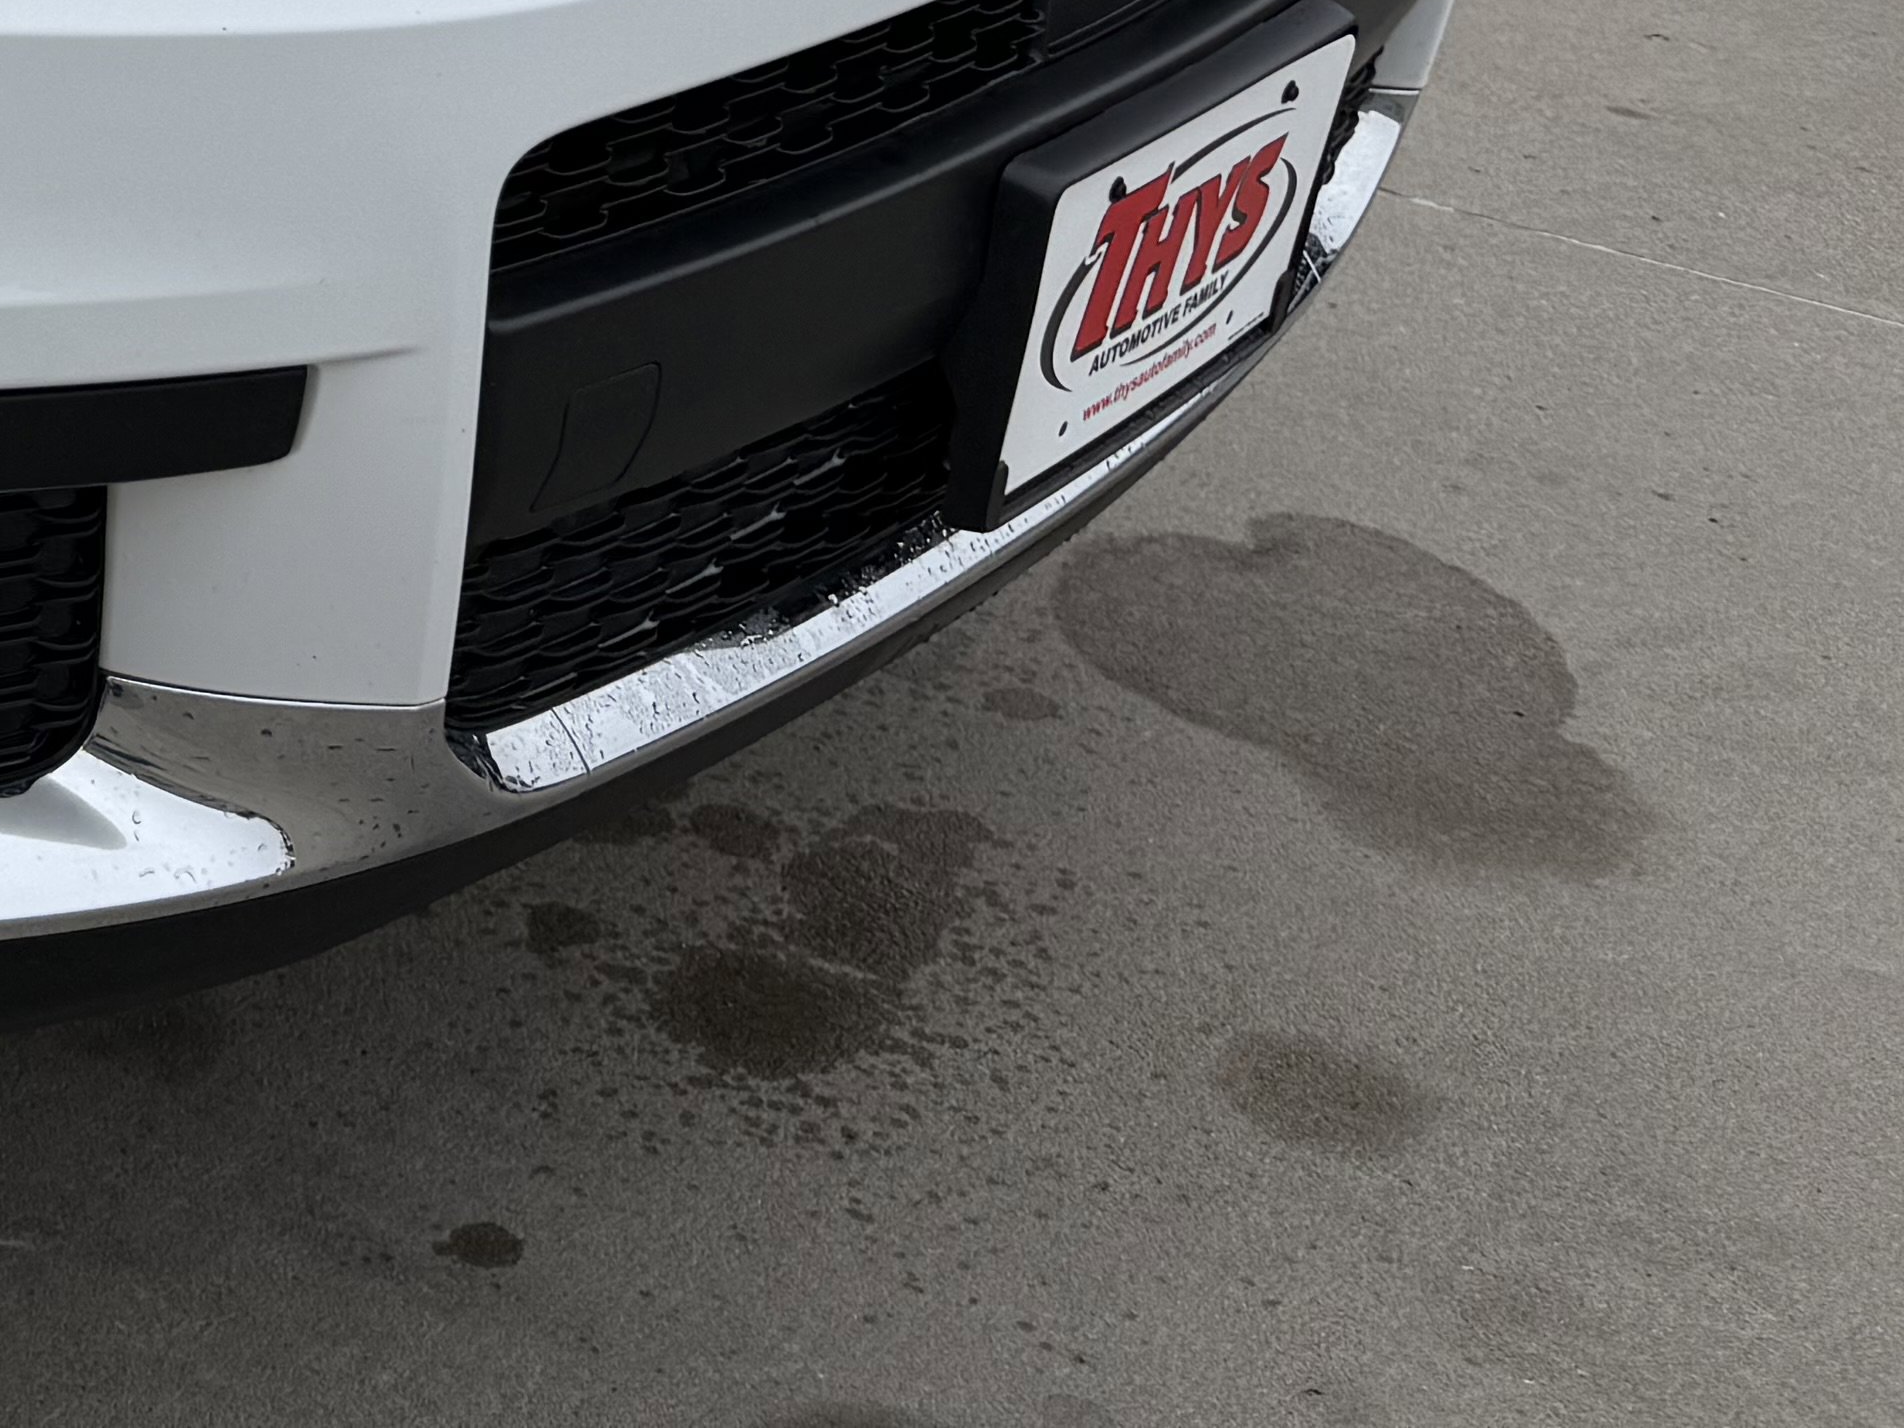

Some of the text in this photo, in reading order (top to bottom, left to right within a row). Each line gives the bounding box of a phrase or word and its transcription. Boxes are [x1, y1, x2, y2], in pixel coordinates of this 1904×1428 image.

[1069, 131, 1290, 362] THYS
[1088, 304, 1181, 376] AUTOMOTIVE
[1182, 270, 1229, 318] FAMILY
